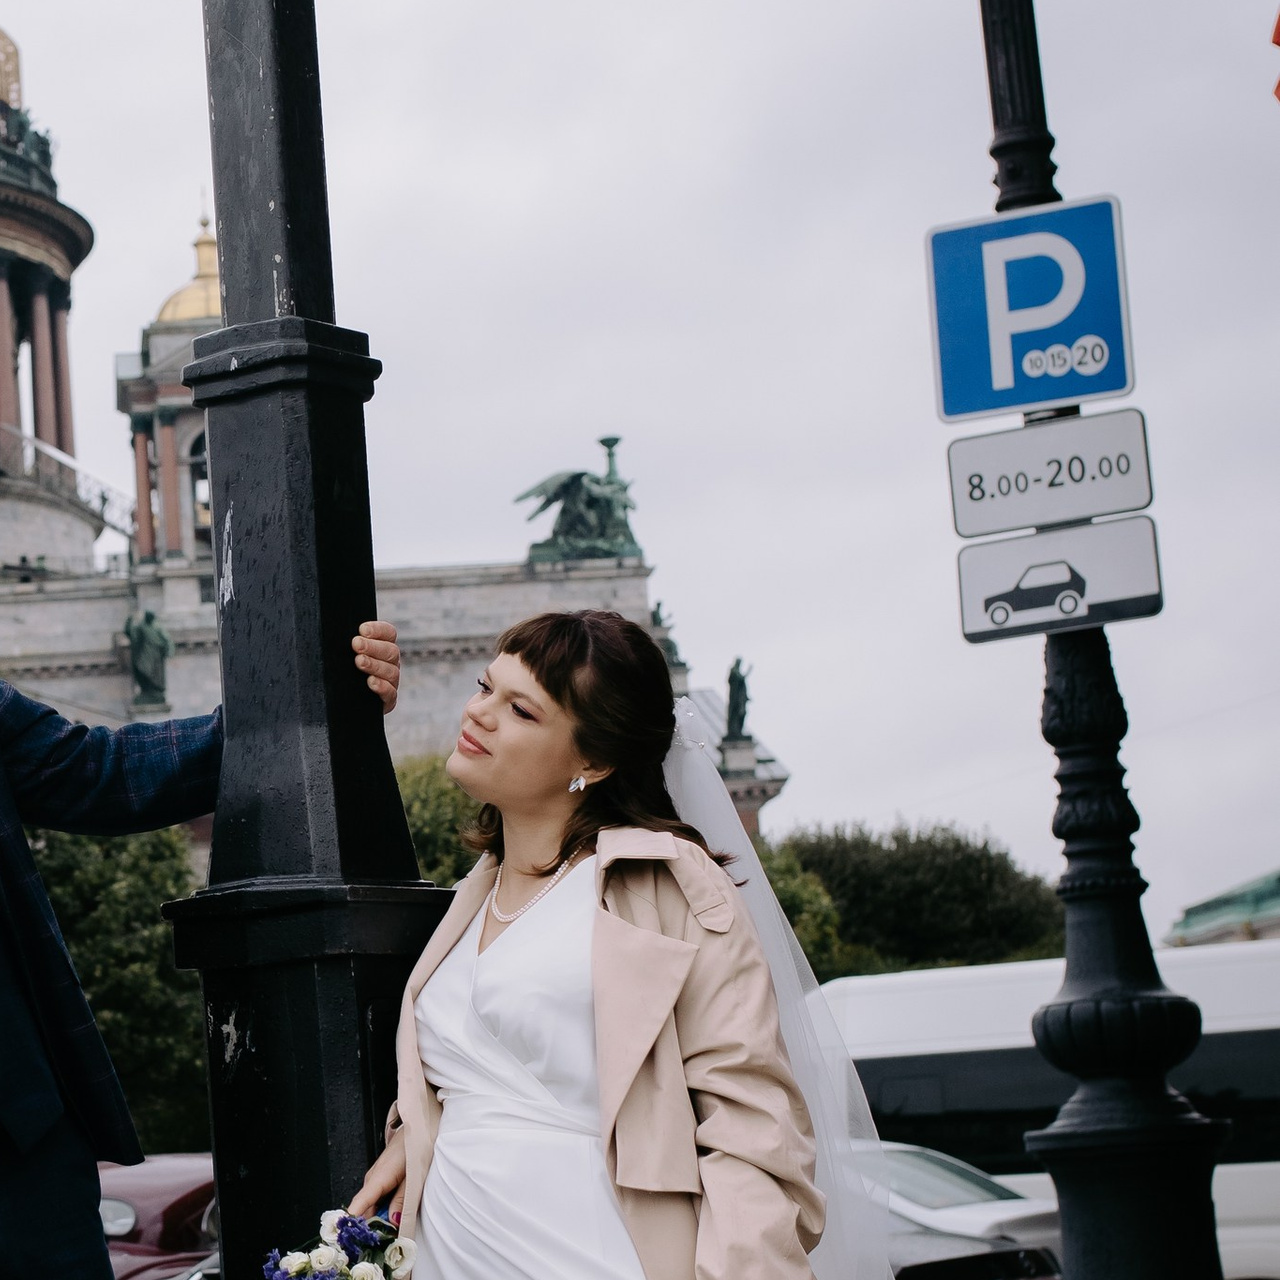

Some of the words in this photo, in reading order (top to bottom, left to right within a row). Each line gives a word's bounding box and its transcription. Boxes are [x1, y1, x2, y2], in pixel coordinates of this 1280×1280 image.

[981, 231, 1086, 391] P
[1028, 355, 1044, 371] 10
[1050, 349, 1067, 369] 15
[1075, 342, 1105, 367] 20
[968, 452, 1131, 502] 8.00-20.00
